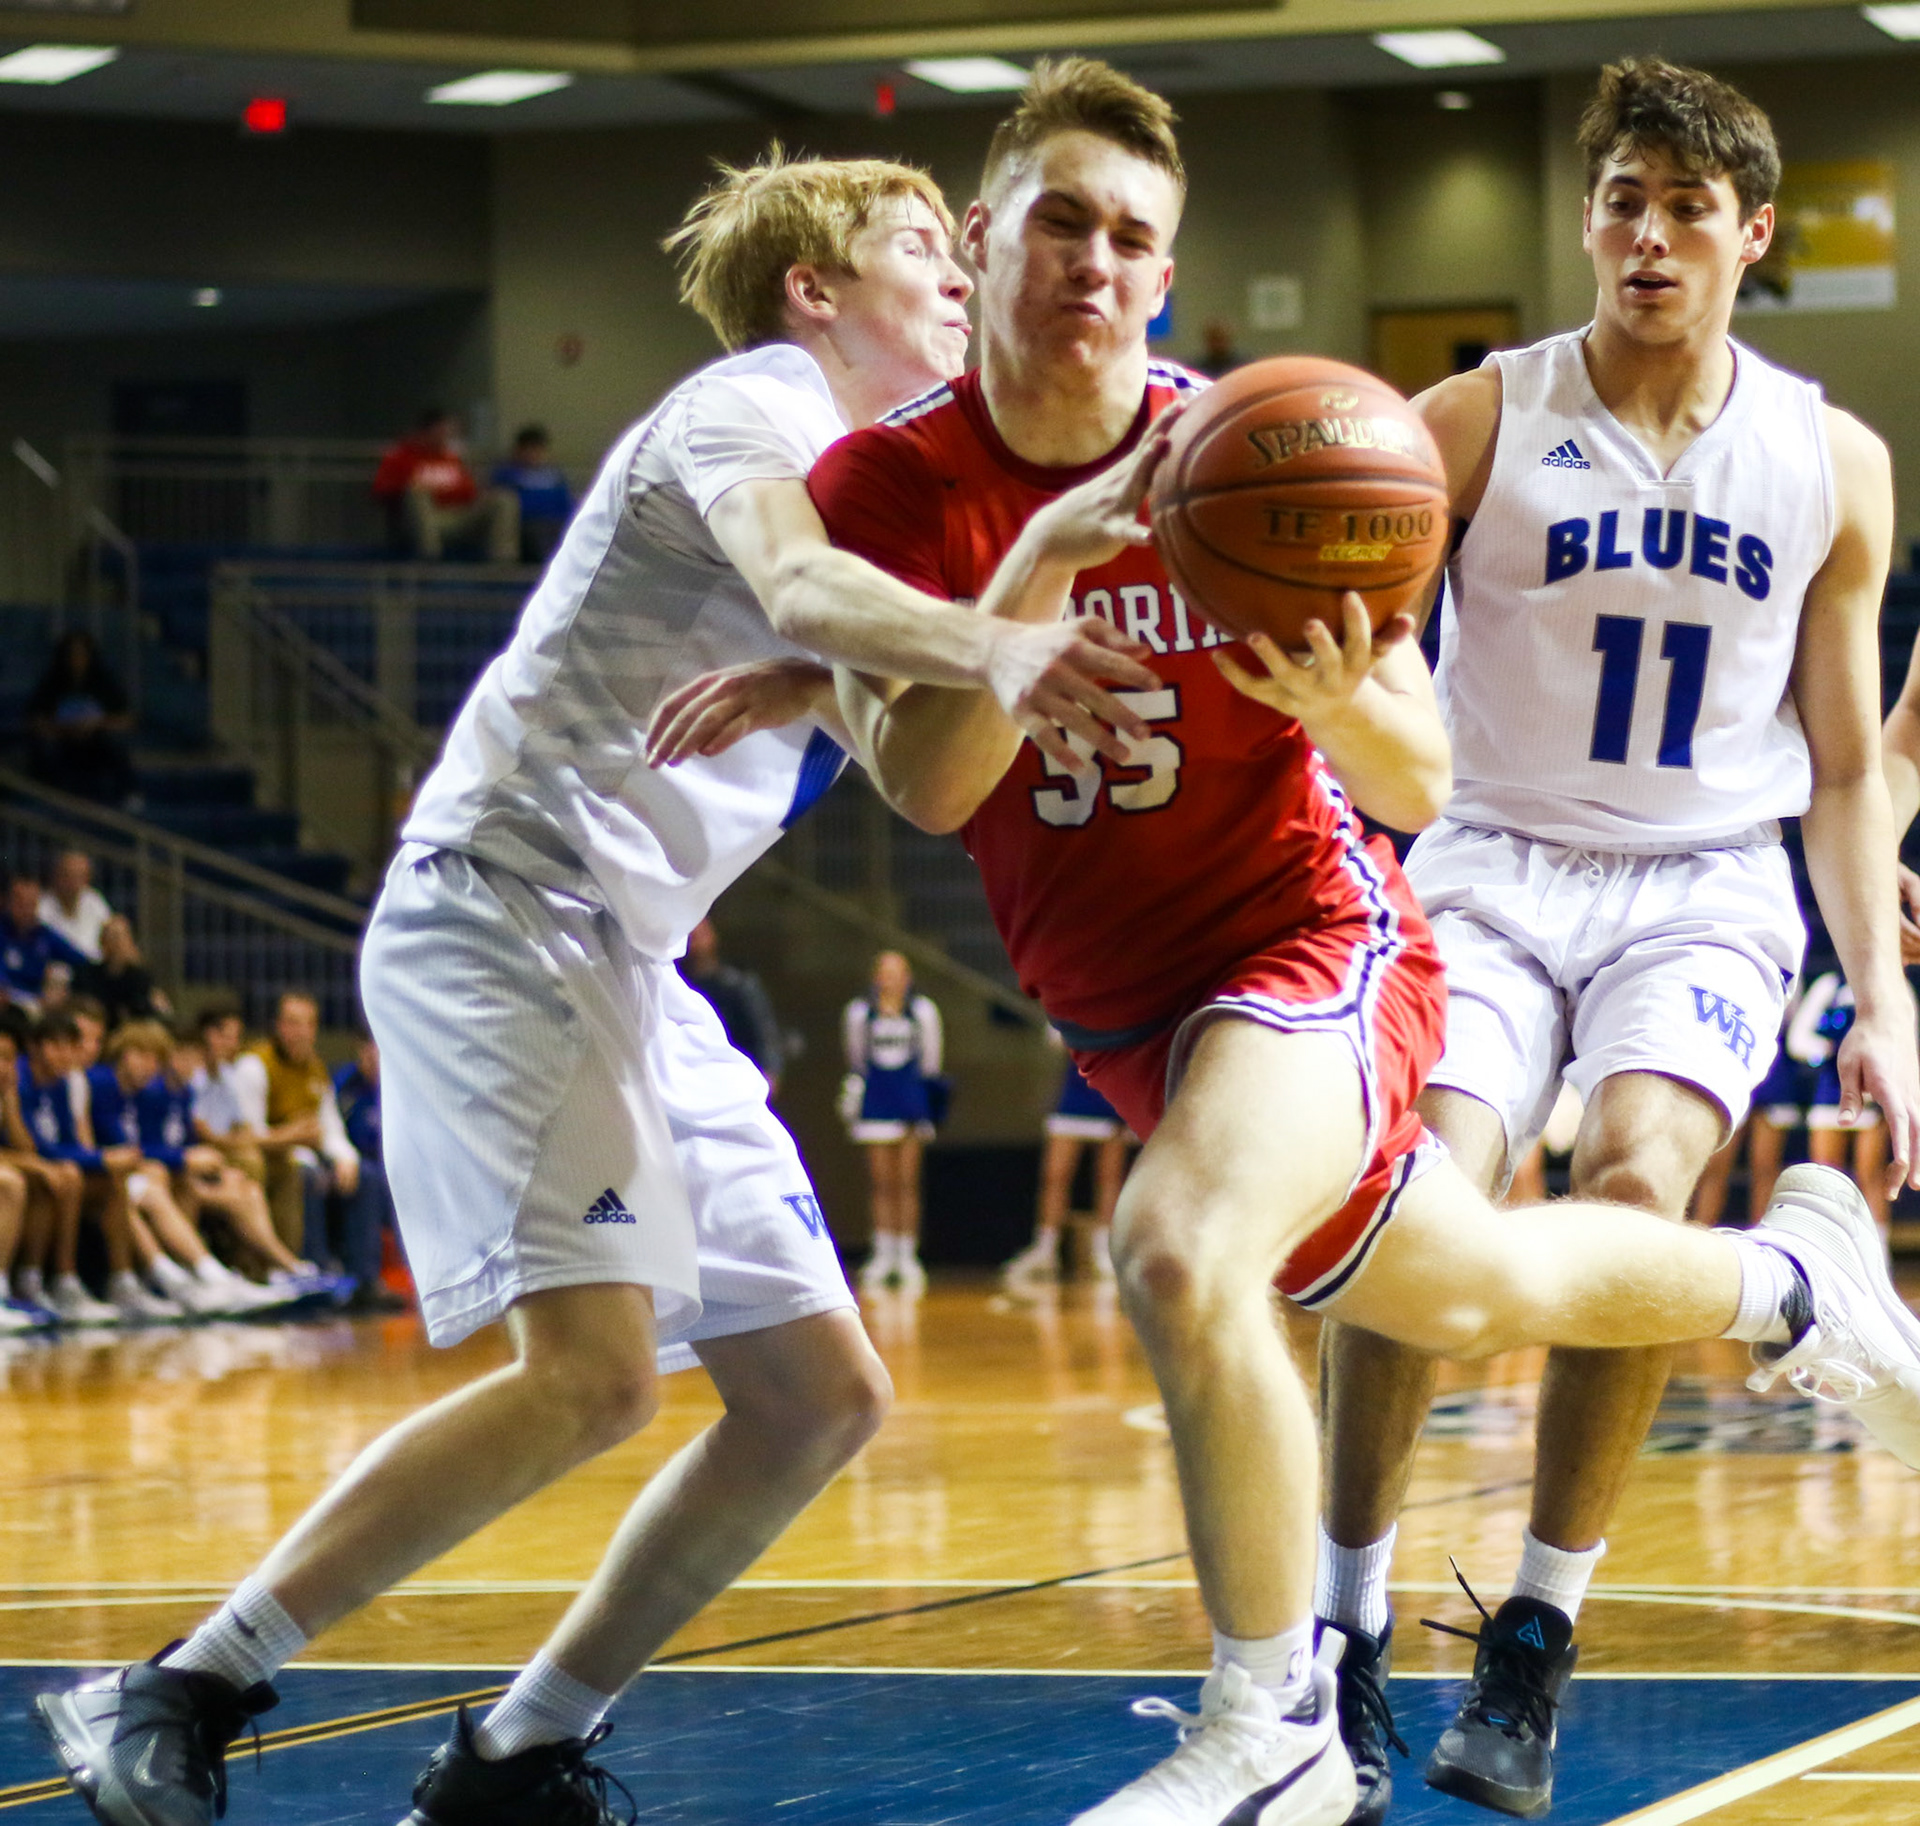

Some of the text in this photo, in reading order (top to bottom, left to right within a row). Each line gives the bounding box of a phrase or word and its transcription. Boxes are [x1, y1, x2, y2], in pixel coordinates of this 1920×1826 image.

[1247, 417, 1432, 473] SPALD
[1541, 457, 1591, 470] adidas
[1544, 507, 1774, 602] BLUES
[1588, 613, 1712, 769] 11
[583, 1209, 637, 1224] adidas
